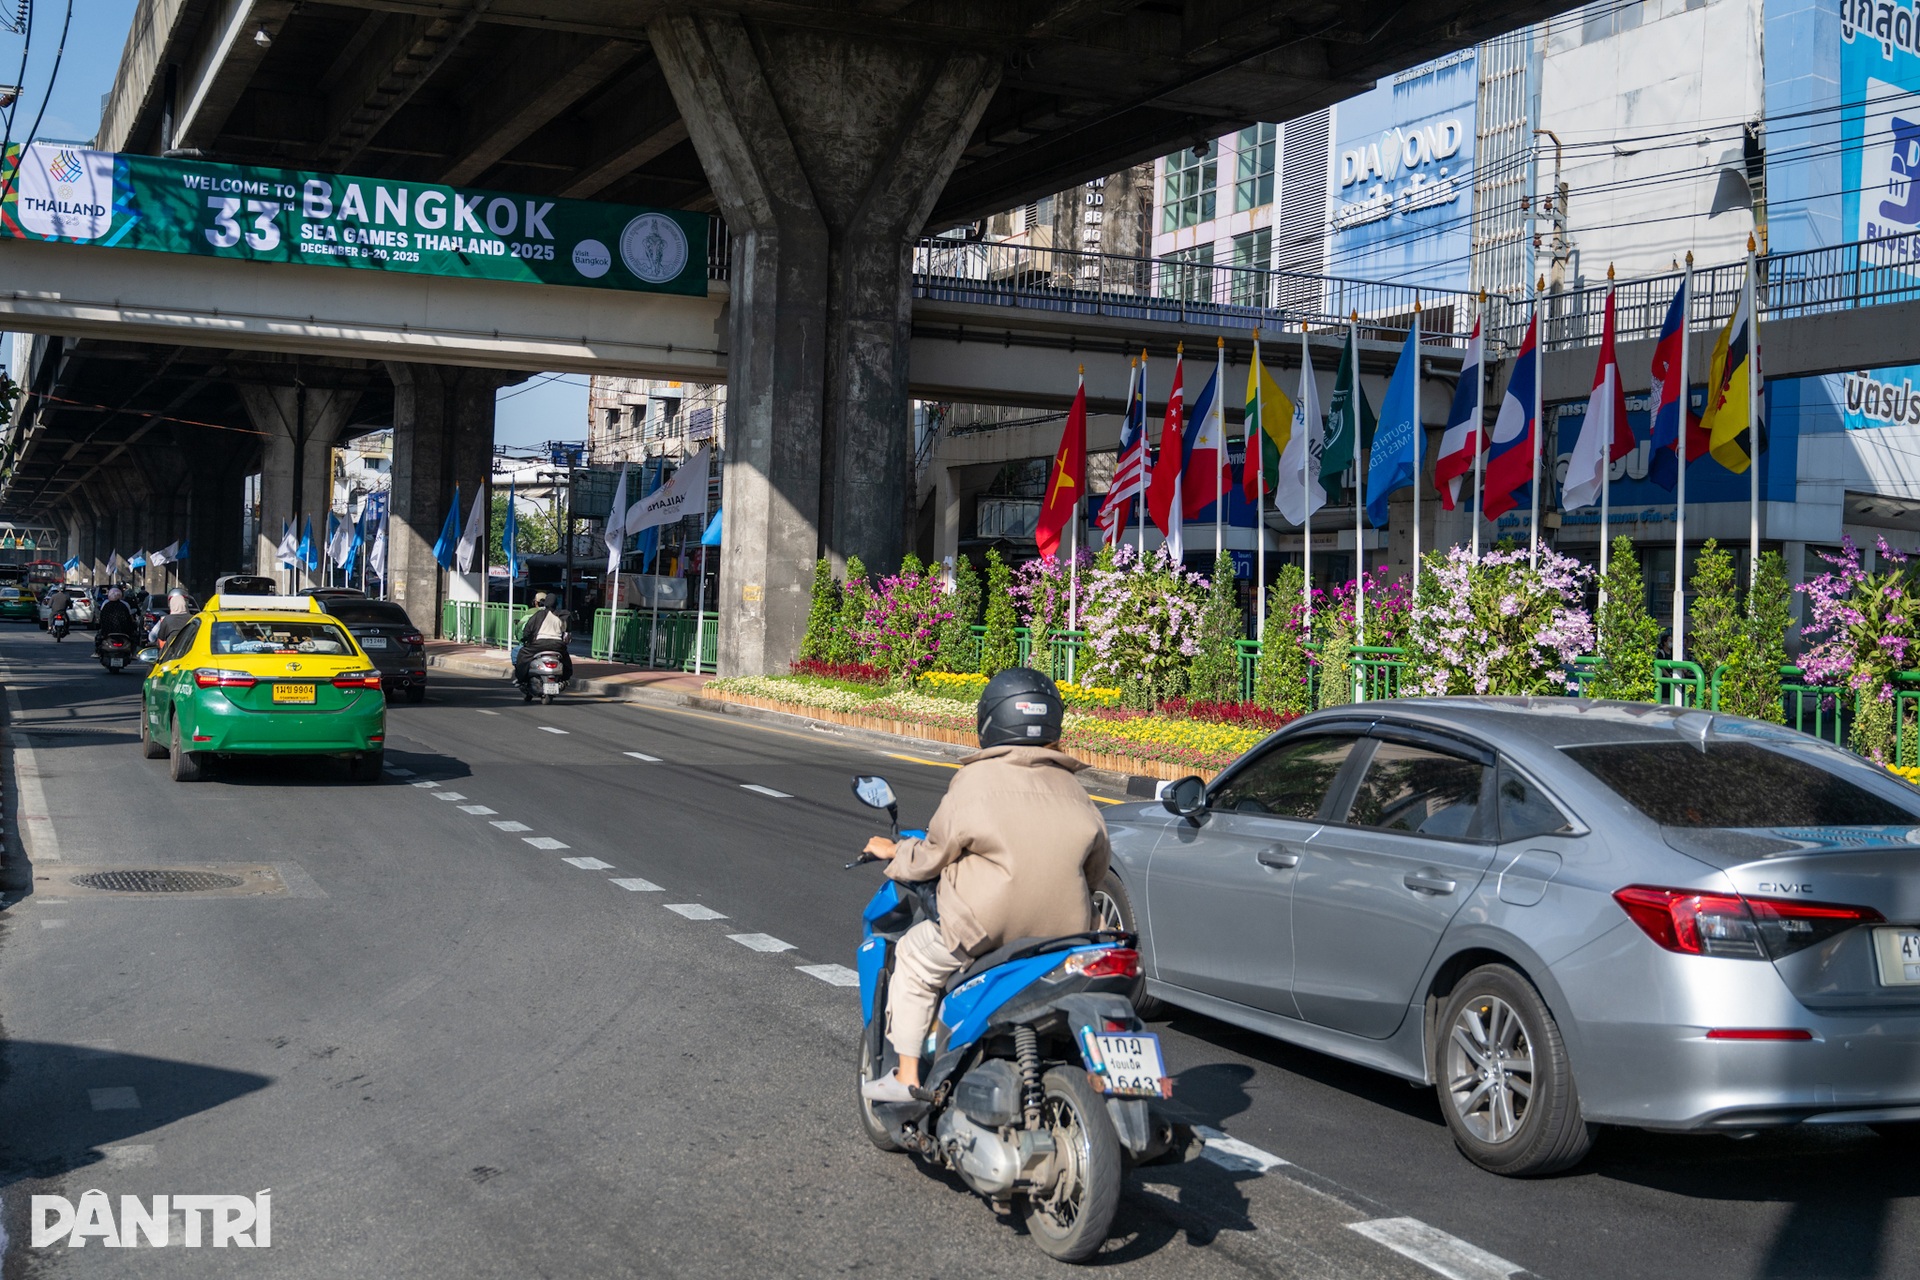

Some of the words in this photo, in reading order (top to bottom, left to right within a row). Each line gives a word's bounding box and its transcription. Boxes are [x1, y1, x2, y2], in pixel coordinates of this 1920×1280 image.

[183, 174, 269, 196] WELCOME
[274, 183, 296, 199] TO
[25, 197, 106, 217] THAILAND
[1338, 184, 1394, 229] smile
[1399, 167, 1461, 214] clinic
[302, 179, 556, 240] BANGKOK
[51, 214, 80, 226] 2025
[300, 223, 338, 242] SEA
[343, 227, 408, 248] GAMES
[414, 233, 505, 256] THAILAND
[510, 242, 555, 261] 2025
[1866, 221, 1908, 255] BLUE
[300, 242, 359, 257] DECEMBER
[361, 249, 390, 261] 9-20,
[393, 252, 420, 262] 2025
[575, 256, 609, 266] Bangkok
[293, 685, 313, 694] 9904
[1758, 882, 1813, 894] CIVIC
